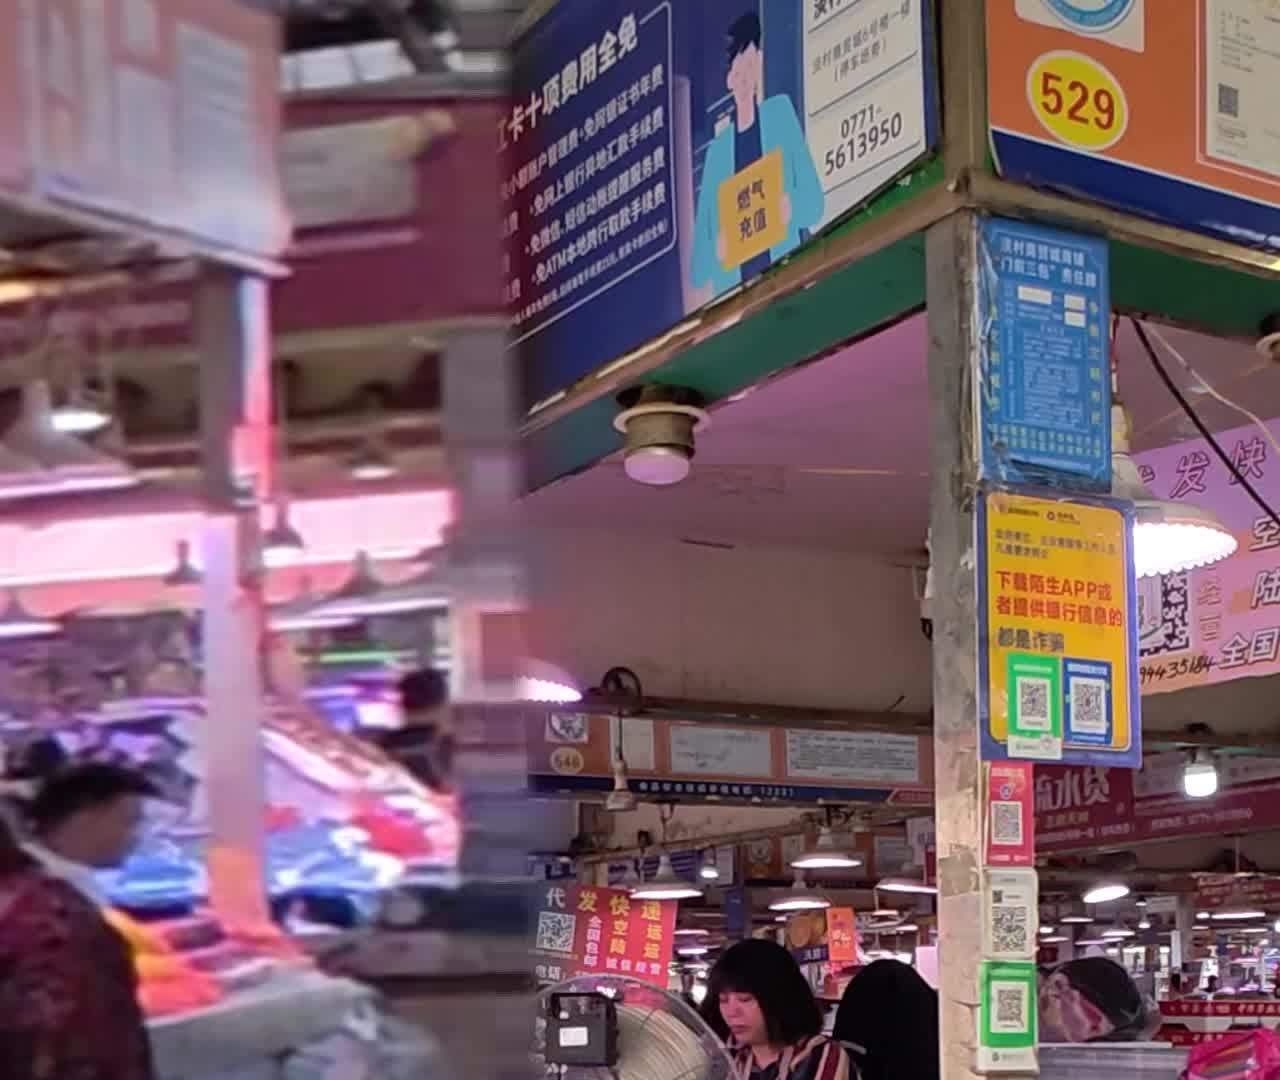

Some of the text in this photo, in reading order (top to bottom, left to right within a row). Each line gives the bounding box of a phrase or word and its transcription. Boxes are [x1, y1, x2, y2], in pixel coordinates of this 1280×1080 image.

[1039, 72, 1116, 133] 529
[825, 112, 902, 177] 5613950
[738, 213, 767, 240] 充值
